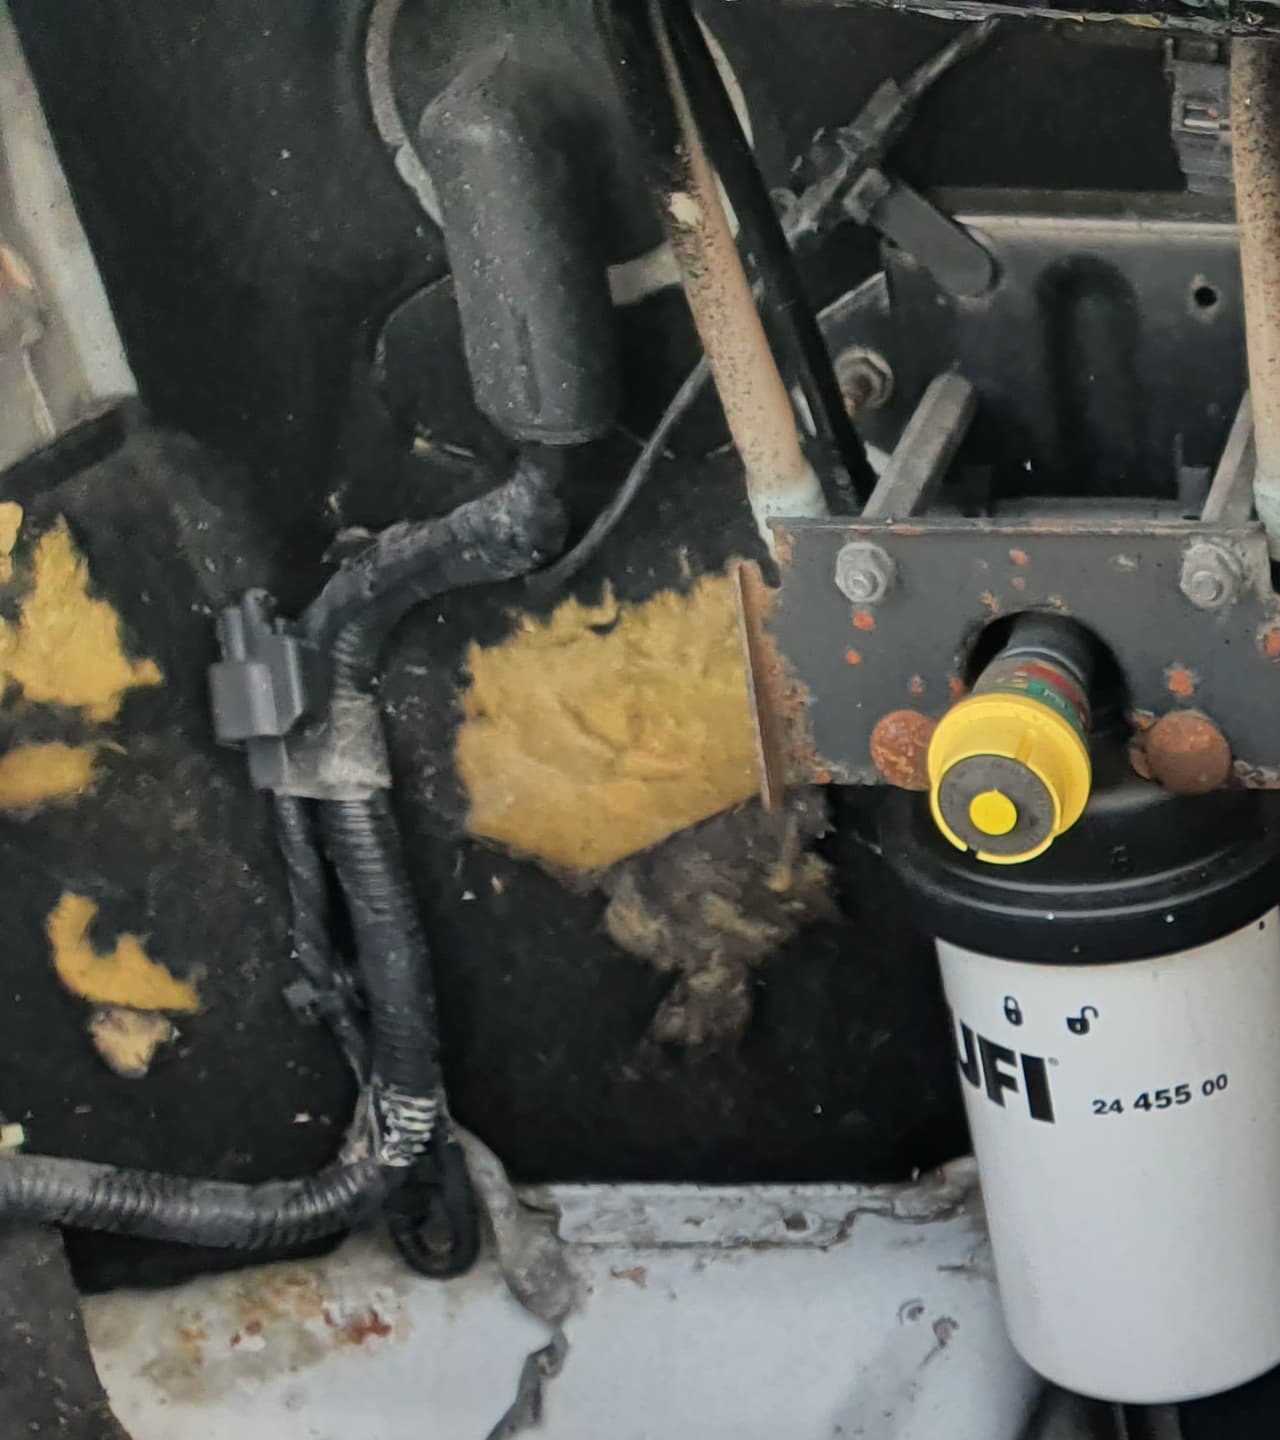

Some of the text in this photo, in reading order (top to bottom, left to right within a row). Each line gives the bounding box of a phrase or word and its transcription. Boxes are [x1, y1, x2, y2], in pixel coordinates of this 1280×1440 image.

[1092, 1073, 1229, 1115] 24 455 00
